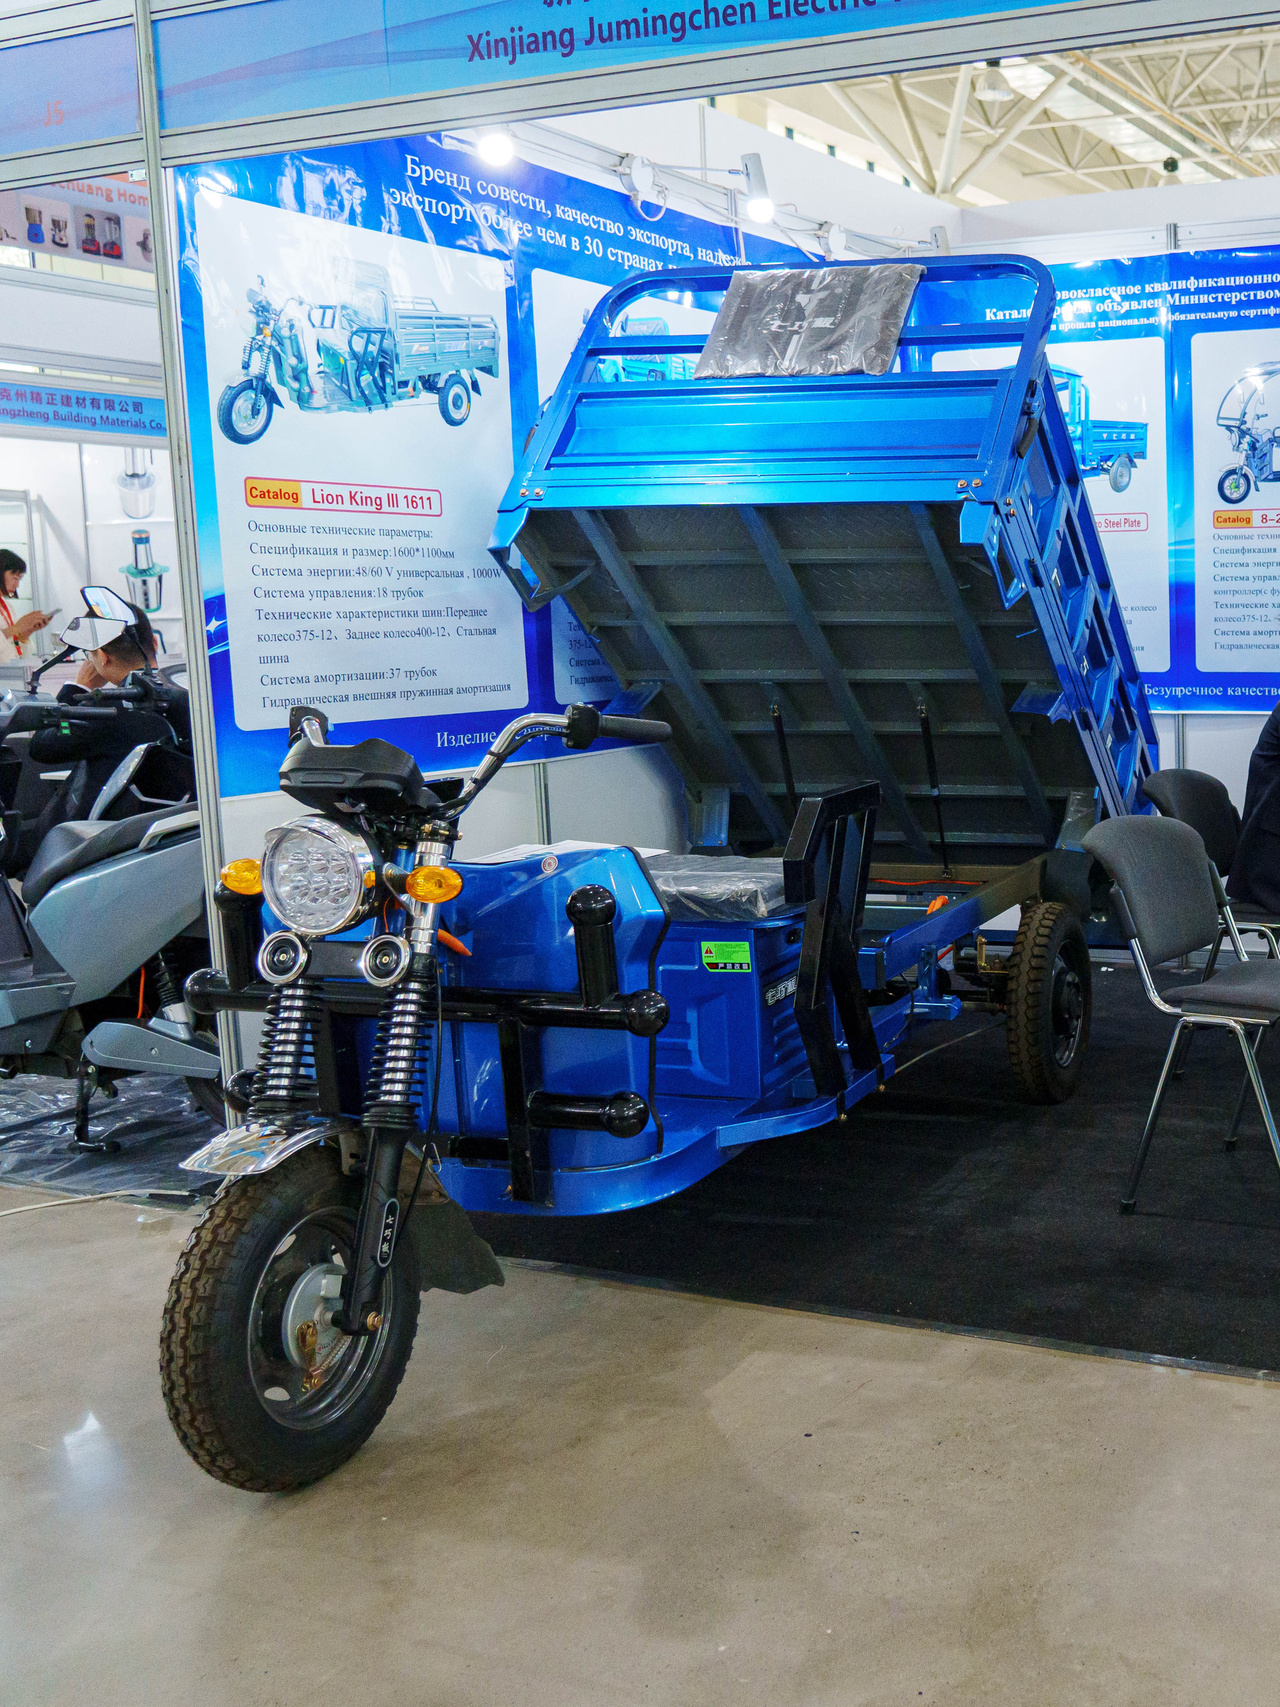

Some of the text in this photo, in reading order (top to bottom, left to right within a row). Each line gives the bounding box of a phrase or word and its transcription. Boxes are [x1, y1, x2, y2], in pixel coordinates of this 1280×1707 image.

[467, 26, 575, 65] Xinjiang
[584, 0, 757, 46] Jumingchen
[43, 100, 64, 127] J5
[50, 181, 114, 202] chuang
[405, 154, 472, 194] Бренд
[477, 180, 552, 218] совести,
[555, 203, 624, 237] качество
[628, 226, 694, 261] экспорта,
[389, 188, 664, 271] экспорт более чем в 30 странах
[1096, 296, 1163, 314] объявлен
[1059, 321, 1096, 333] прошла
[1098, 315, 1167, 329] национальну
[53, 410, 97, 427] Building
[100, 415, 147, 430] Materials
[249, 486, 299, 504] Catalog
[312, 488, 344, 505] Lion
[349, 490, 382, 511] King
[403, 494, 432, 511] 1611
[1104, 518, 1122, 529] Steel
[1123, 517, 1141, 528] Plate
[1216, 516, 1251, 525] Catalog
[248, 520, 434, 541] Основные технические параметры:
[1212, 533, 1255, 541] Основные
[249, 542, 338, 558] Спецификация
[342, 546, 349, 556] и
[1212, 546, 1277, 556] Спецификация
[1213, 560, 1250, 568] Система
[251, 564, 303, 577] Система
[306, 566, 383, 580] энергии:48/60
[385, 566, 394, 577] V
[396, 568, 465, 581] универсальная
[472, 568, 503, 579] 1000W
[1213, 573, 1250, 582] Система
[253, 586, 424, 600] Система управления:18 трубок
[1213, 601, 1270, 609] Технические
[255, 606, 488, 621] Технические характеристики шин:Переднее
[345, 628, 380, 641] Заднее
[456, 626, 497, 638] Стальная
[1214, 628, 1250, 636] Система
[1214, 641, 1280, 651] Гидравлическая
[259, 654, 290, 665] шина
[260, 667, 438, 687] Система амортизации:37 трубок
[262, 682, 511, 709] Гидравлическая внешняя пружинная амортизация
[1144, 684, 1223, 699] Безупречное
[436, 729, 497, 749] Изделие
